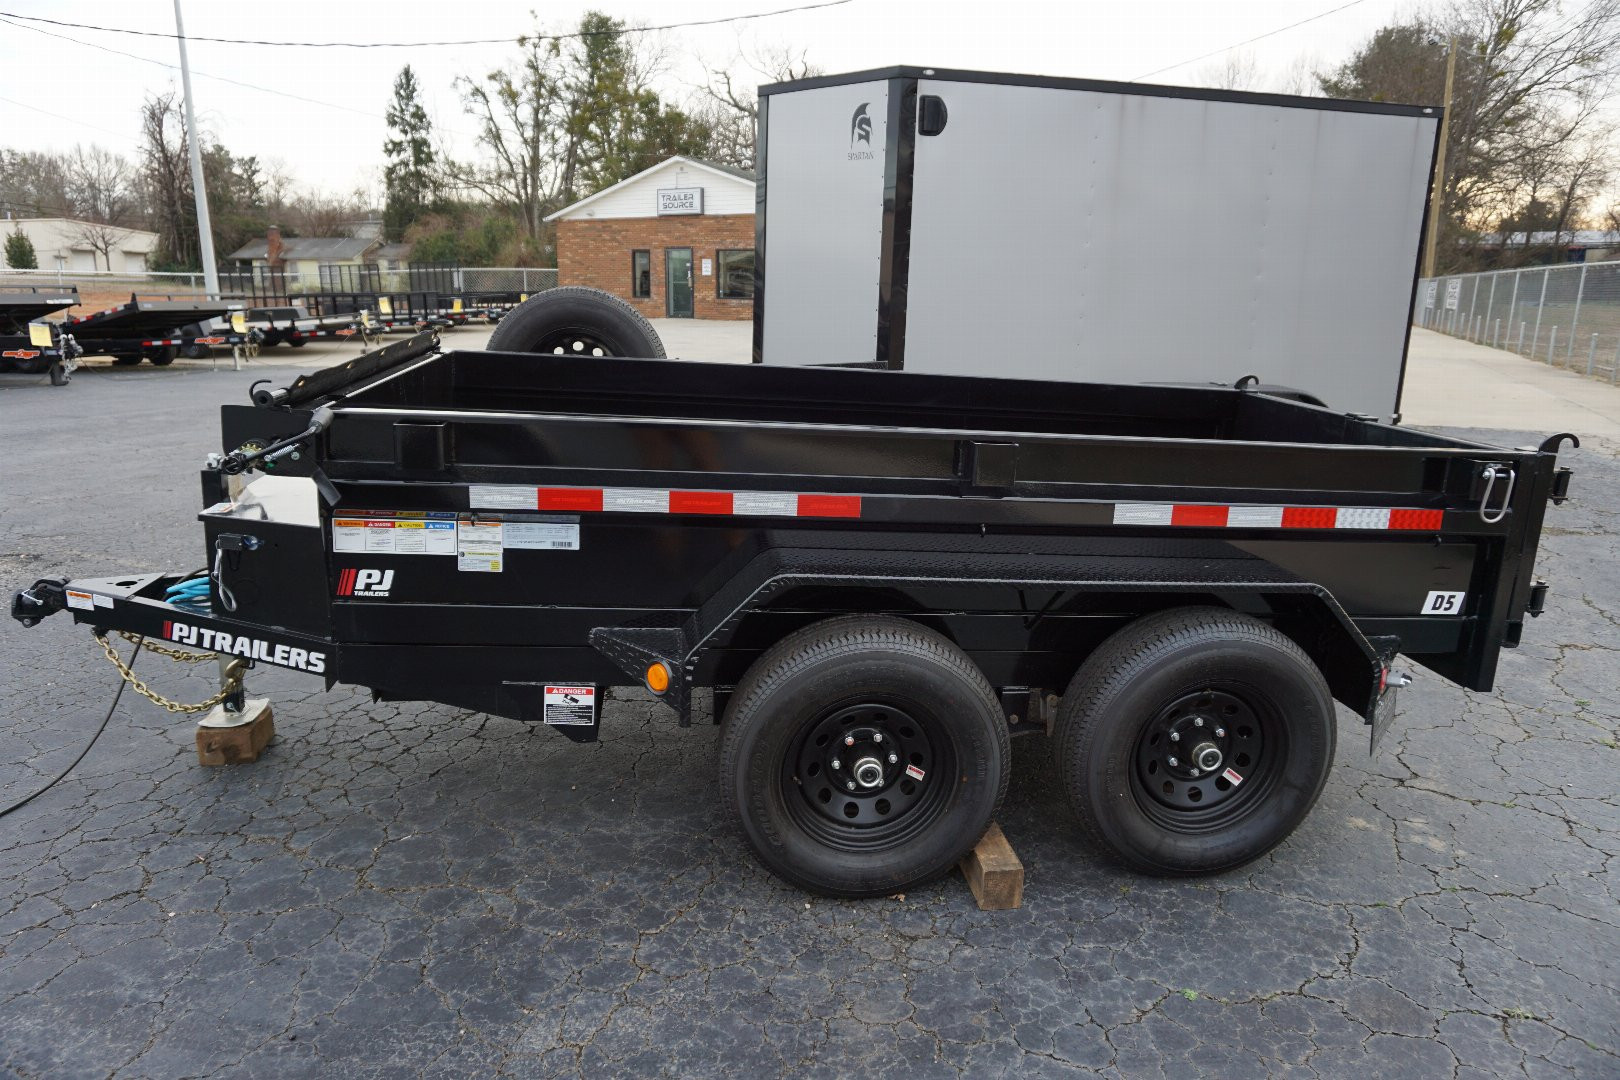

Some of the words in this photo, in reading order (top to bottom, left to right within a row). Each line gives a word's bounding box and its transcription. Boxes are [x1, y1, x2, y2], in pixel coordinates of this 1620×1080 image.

[847, 152, 874, 161] SPARTAN
[661, 194, 694, 202] TRAILER
[355, 569, 394, 590] PJ
[1431, 595, 1456, 611] D5
[171, 622, 198, 645] PJ
[199, 628, 326, 673] TRAILERS
